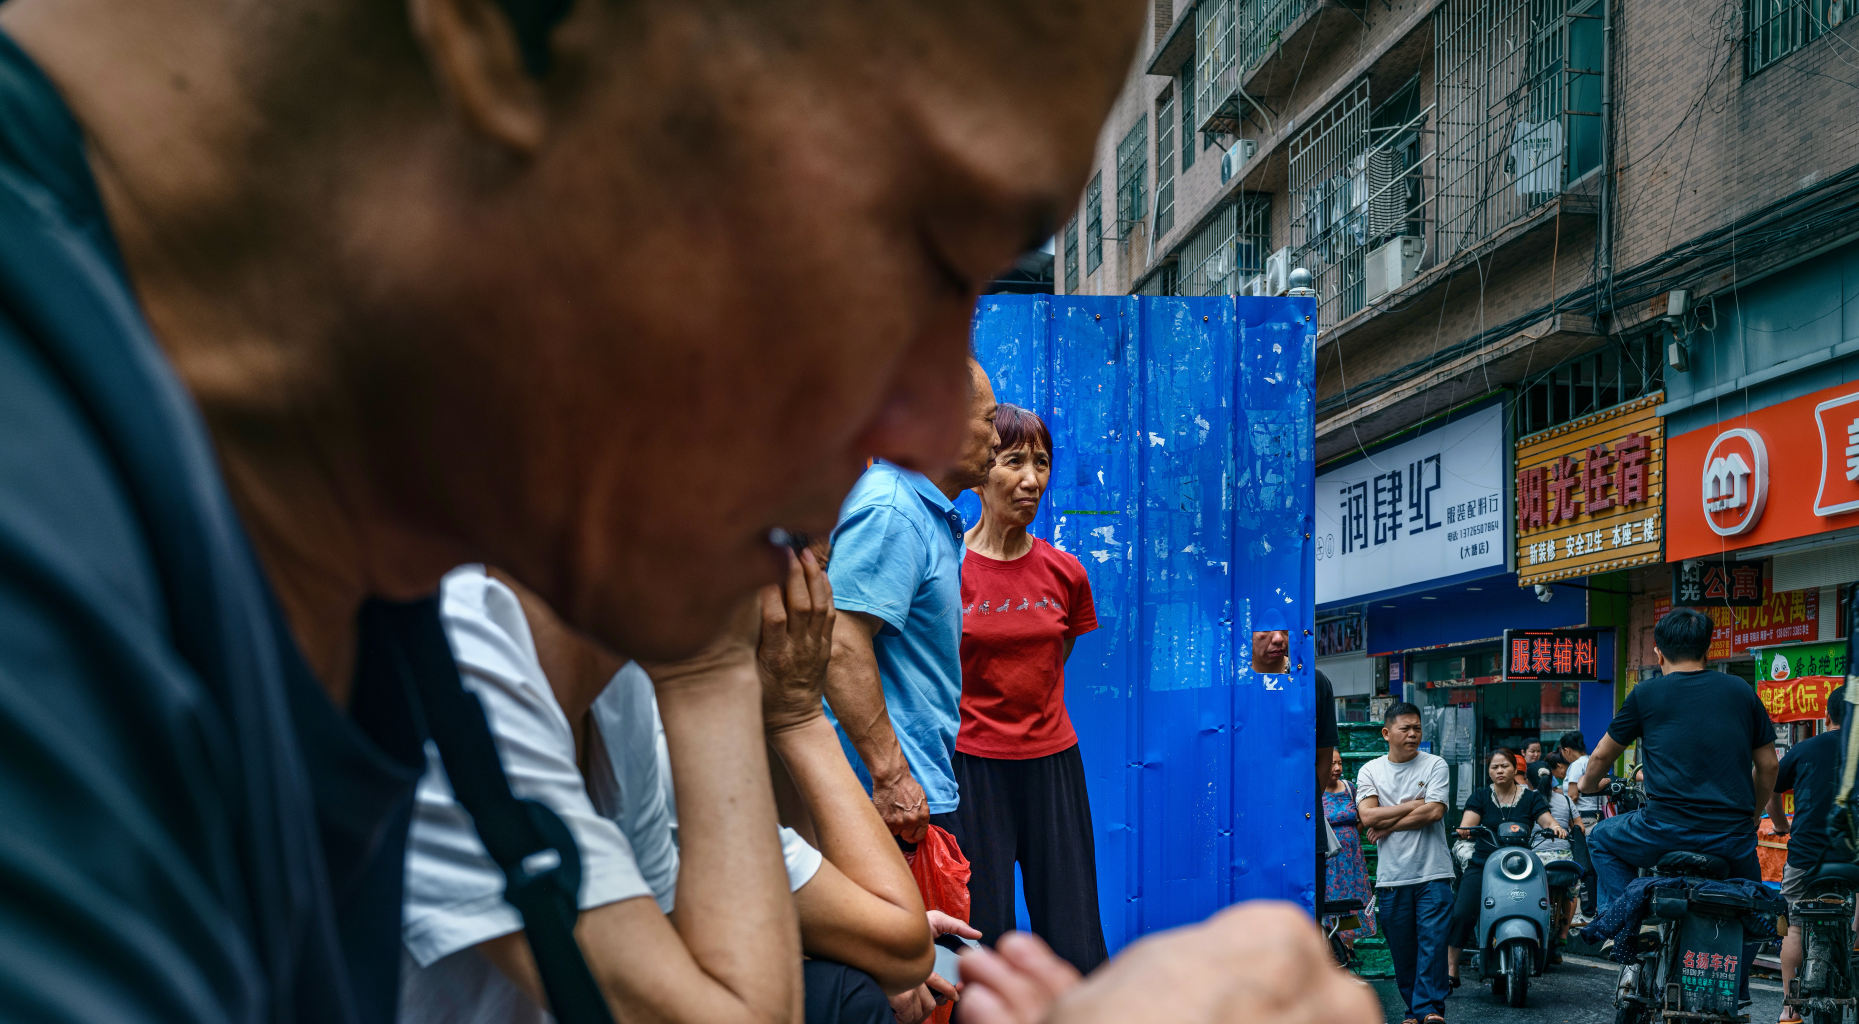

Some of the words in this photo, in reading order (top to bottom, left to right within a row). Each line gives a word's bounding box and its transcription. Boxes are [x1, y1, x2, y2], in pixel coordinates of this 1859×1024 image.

[1518, 432, 1651, 531] 阳光住宿
[1447, 493, 1499, 525] 服装配料行
[1529, 539, 1556, 565] 新装修
[1566, 529, 1603, 558] 安全卫生
[1612, 517, 1654, 548] 本座二楼
[1703, 566, 1759, 599] 公寓
[1511, 638, 1594, 674] 服装辅料
[1683, 950, 1738, 973] 名扬车行
